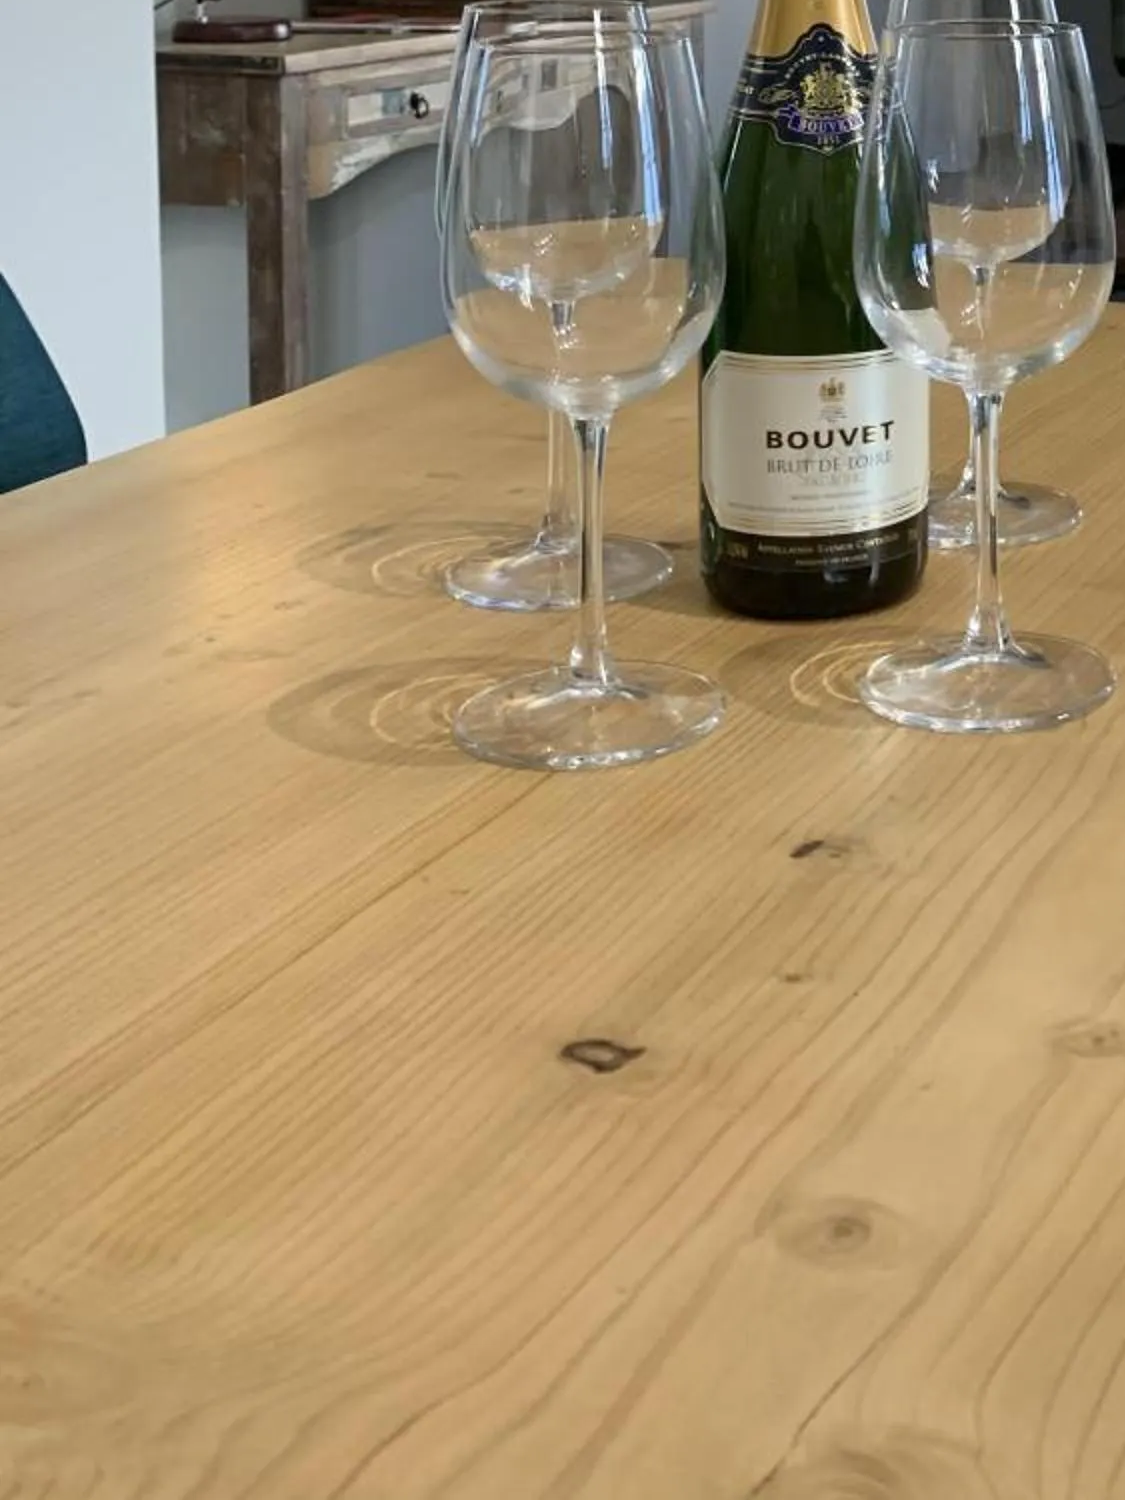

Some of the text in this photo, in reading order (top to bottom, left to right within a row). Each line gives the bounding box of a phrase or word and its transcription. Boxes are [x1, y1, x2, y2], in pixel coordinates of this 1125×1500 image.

[766, 420, 894, 449] BOUVET
[767, 458, 813, 474] BRUT
[819, 457, 840, 472] DE
